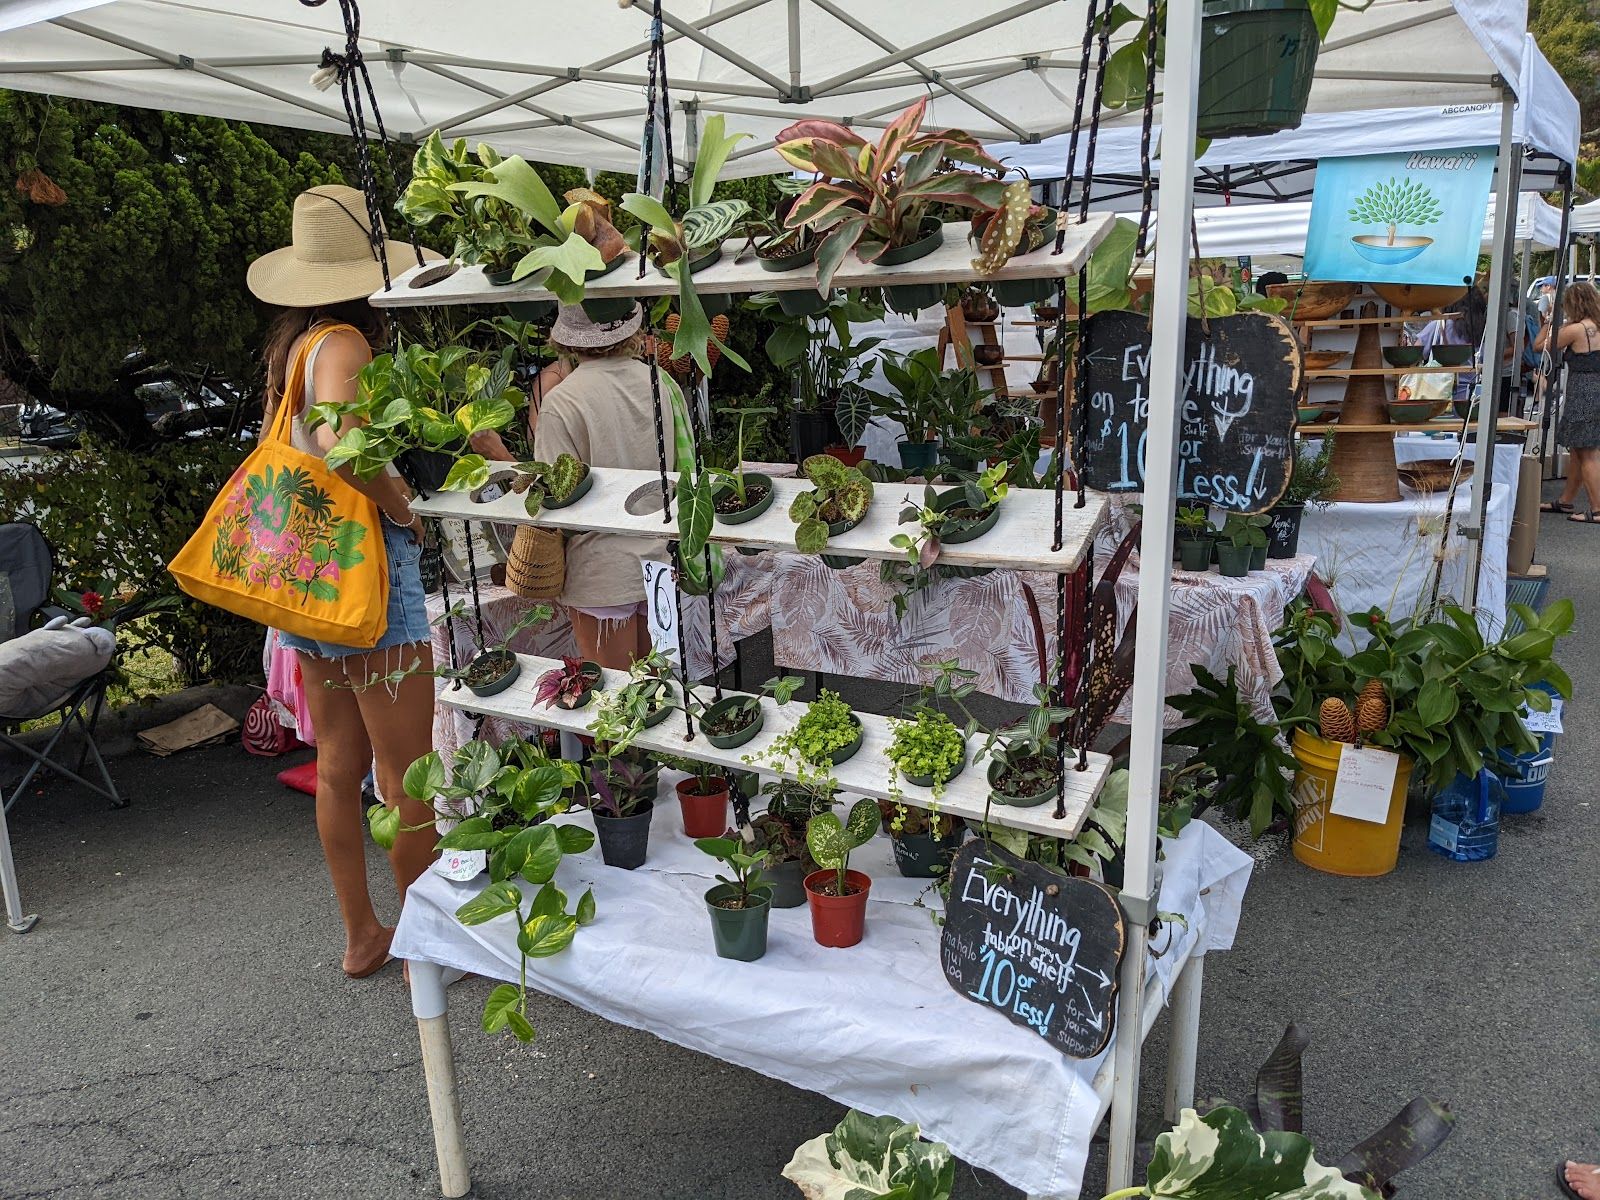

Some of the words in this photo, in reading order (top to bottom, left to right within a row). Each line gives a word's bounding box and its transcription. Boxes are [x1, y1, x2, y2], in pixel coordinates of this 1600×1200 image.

[1441, 103, 1493, 115] ABCCANOPY
[1121, 343, 1254, 417] Evything
[1091, 391, 1115, 417] on
[1126, 382, 1201, 424] tae
[1179, 440, 1202, 460] or
[961, 857, 1082, 967] Everything
[943, 931, 977, 961] mahalo
[982, 921, 1016, 958] table
[944, 947, 963, 967] nui
[1017, 973, 1038, 989] or
[1029, 953, 1076, 994] shelf
[1013, 990, 1055, 1036] Less!
[1065, 998, 1085, 1021] for
[1063, 1014, 1089, 1036] your
